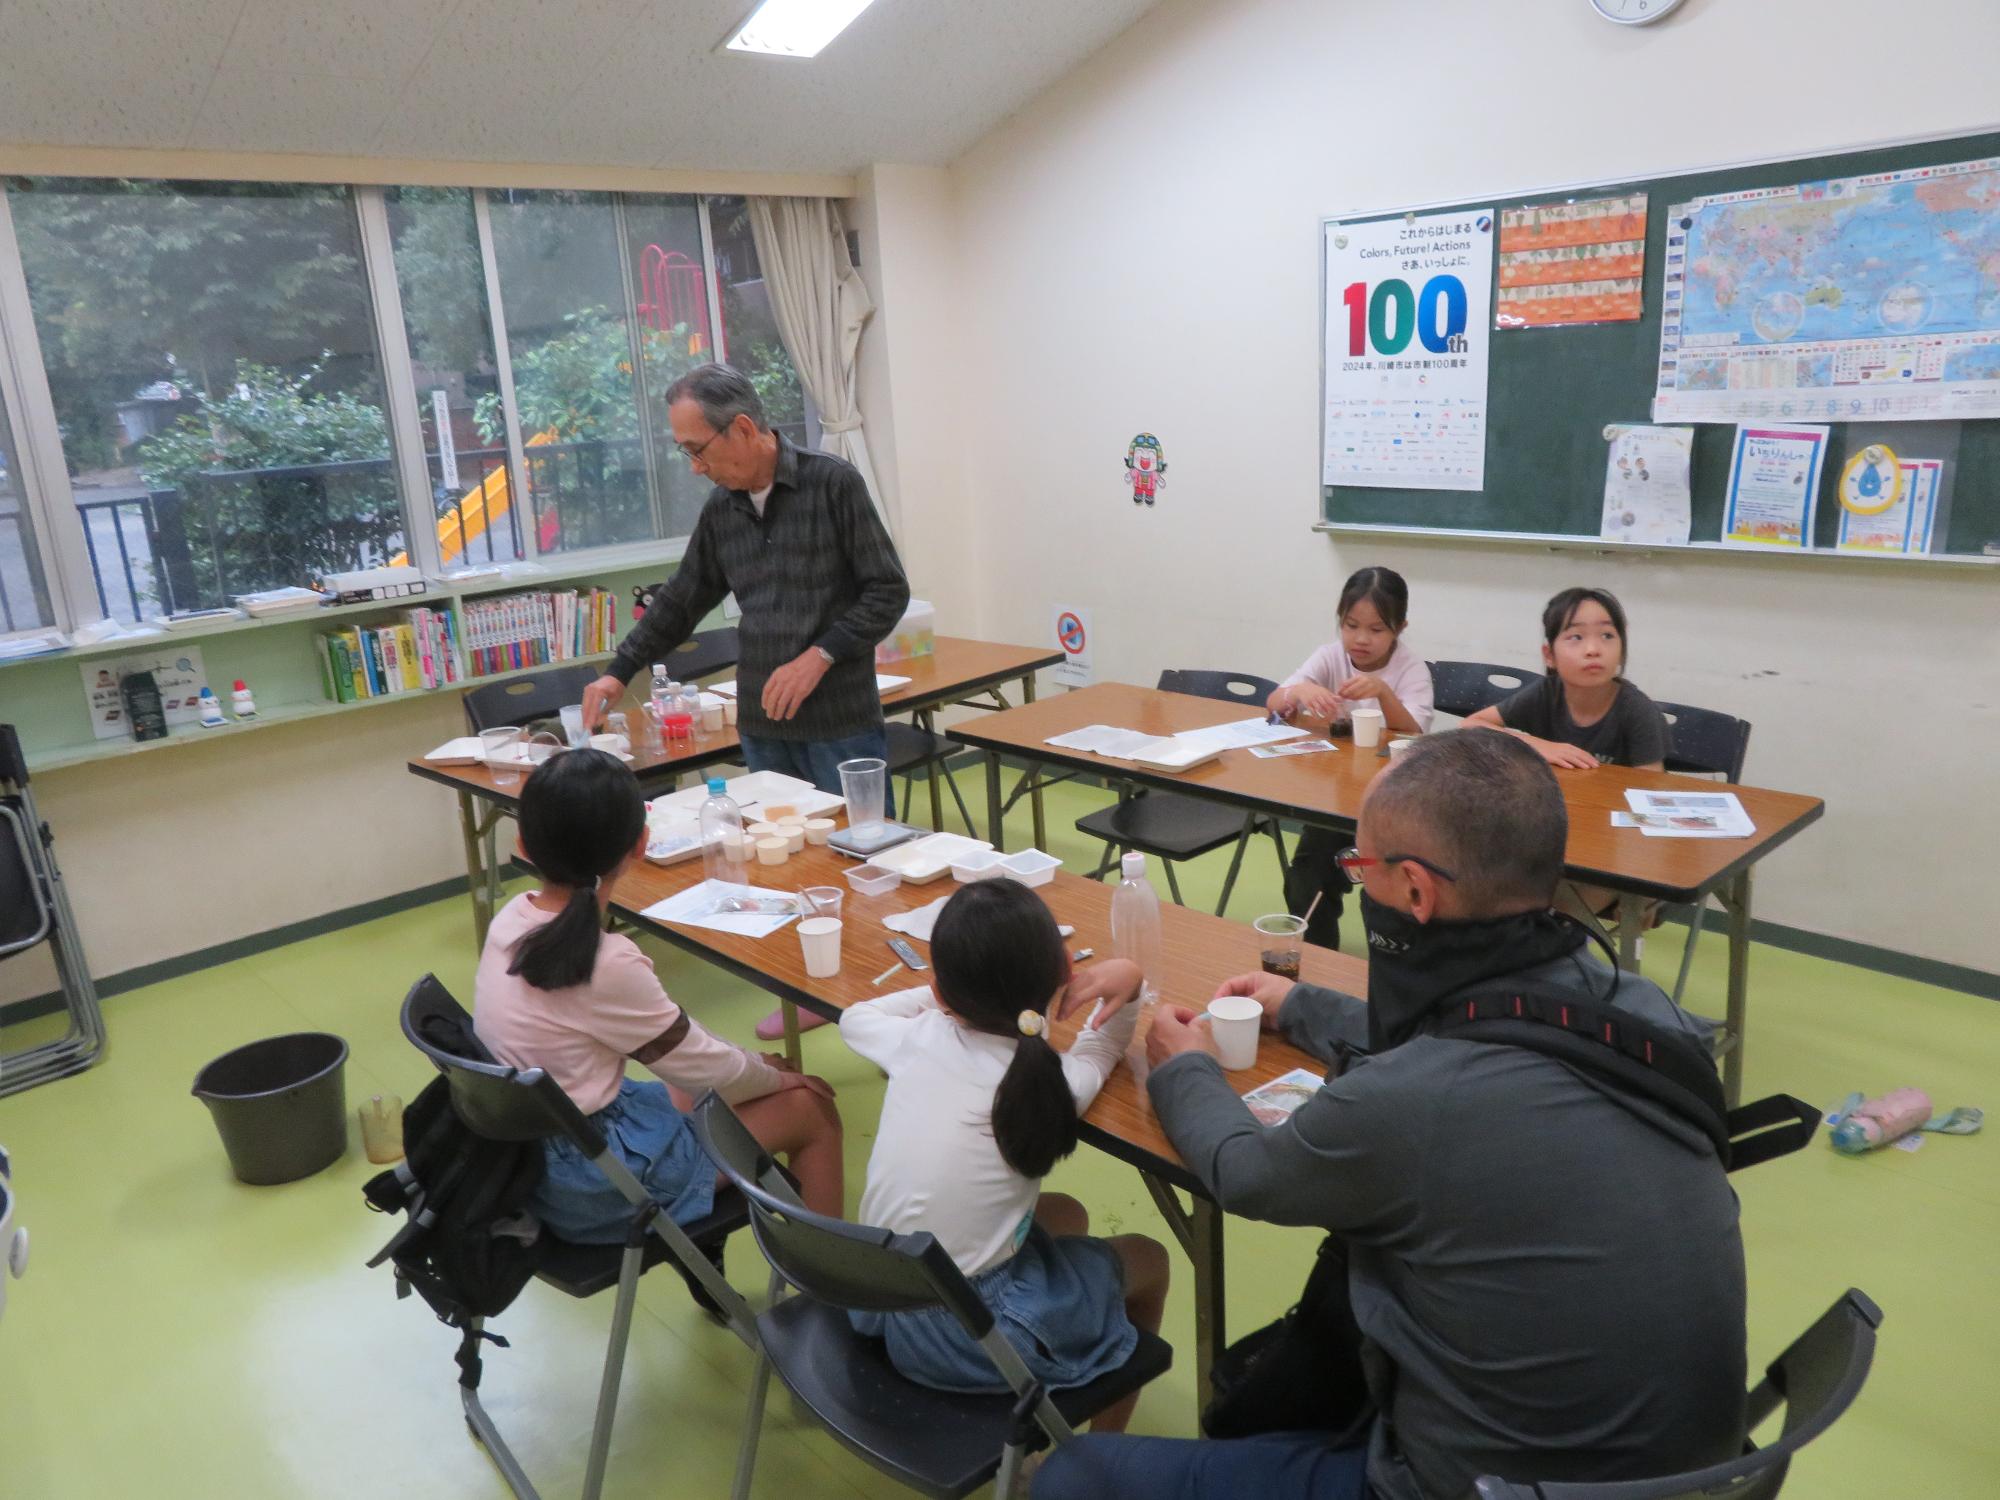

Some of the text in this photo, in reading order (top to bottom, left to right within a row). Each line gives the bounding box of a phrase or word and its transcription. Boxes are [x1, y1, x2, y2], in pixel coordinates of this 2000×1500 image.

[1400, 223, 1471, 240] これからはじまる
[1360, 240, 1471, 259] Colors, Future! Actions
[1402, 255, 1470, 270] さあ、いっしょに。
[1782, 401, 1792, 416] 6
[1827, 399, 1837, 415] 8
[1851, 399, 1862, 414] 9
